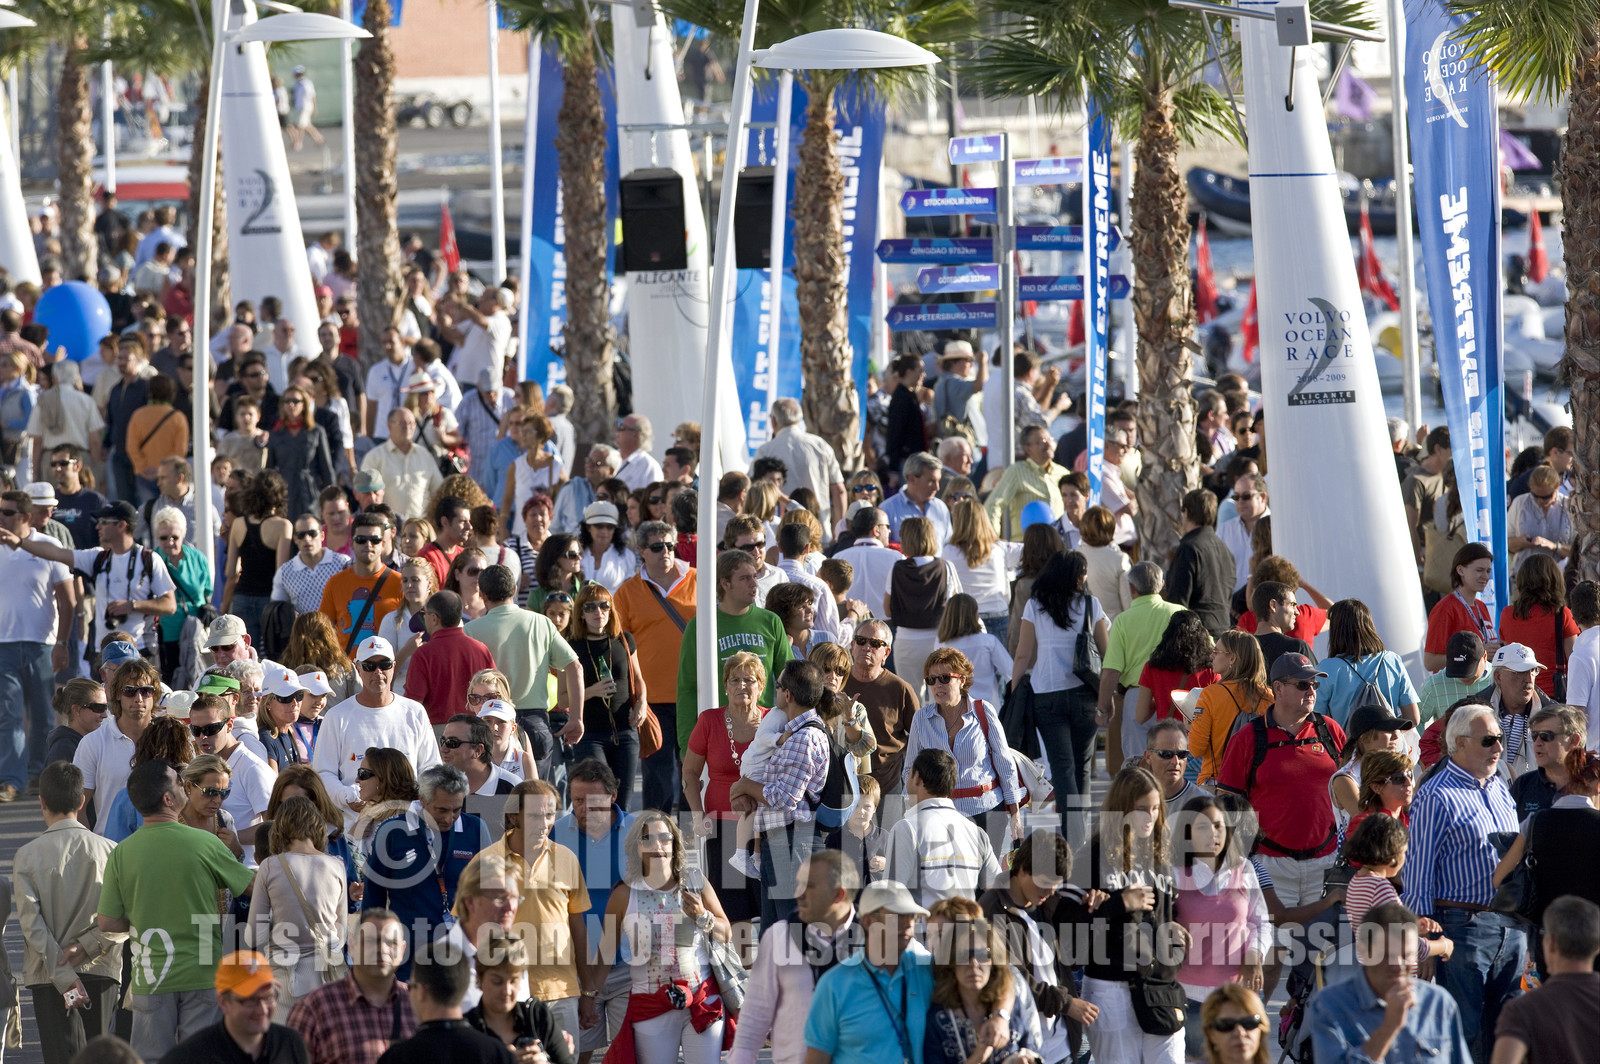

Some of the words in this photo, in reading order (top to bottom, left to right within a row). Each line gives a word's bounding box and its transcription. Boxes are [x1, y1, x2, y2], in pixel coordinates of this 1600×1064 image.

[923, 197, 964, 207] STOCKHOLM
[1093, 150, 1109, 335] EXTREME
[909, 246, 947, 255] QINGDAO
[635, 270, 700, 284] ALICANTE
[1022, 284, 1036, 292] RIO
[1037, 284, 1048, 292] DE
[1049, 283, 1082, 292] JANEIRO
[904, 314, 915, 322] ST.
[916, 312, 967, 321] PETERSBURG
[1285, 310, 1350, 325] VOLVO
[1285, 327, 1351, 343] OCEAN
[1286, 344, 1353, 361] RACE
[1091, 344, 1105, 419] THE
[1293, 392, 1352, 400] ALICANTE
[1090, 428, 1104, 482] AT
[718, 633, 765, 652] HILFIGER
